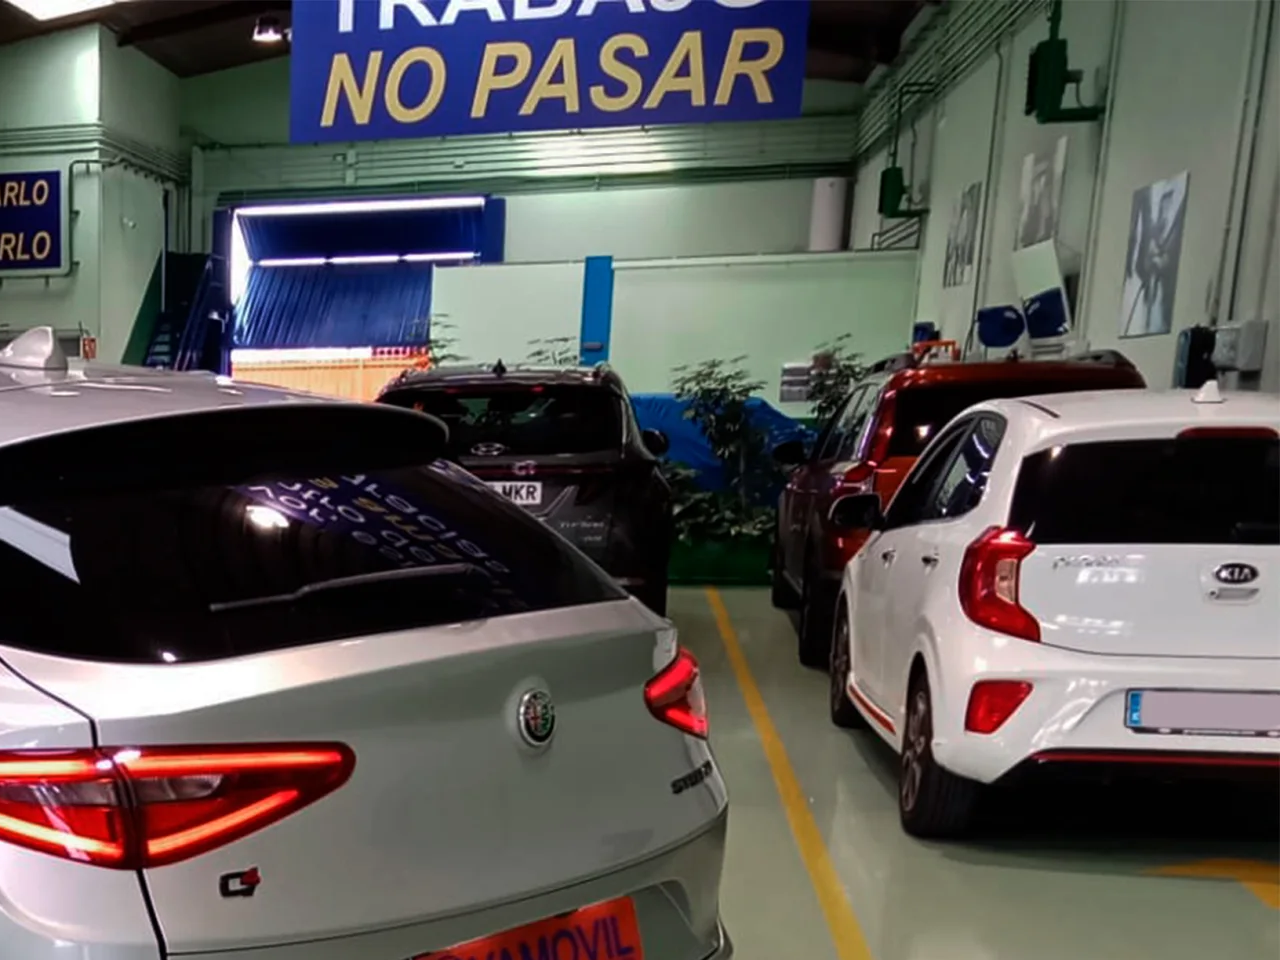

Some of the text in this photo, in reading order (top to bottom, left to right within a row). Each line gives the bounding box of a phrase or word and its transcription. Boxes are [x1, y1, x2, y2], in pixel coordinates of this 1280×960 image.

[321, 27, 784, 127] NO PASAR
[1218, 566, 1253, 582] KIA
